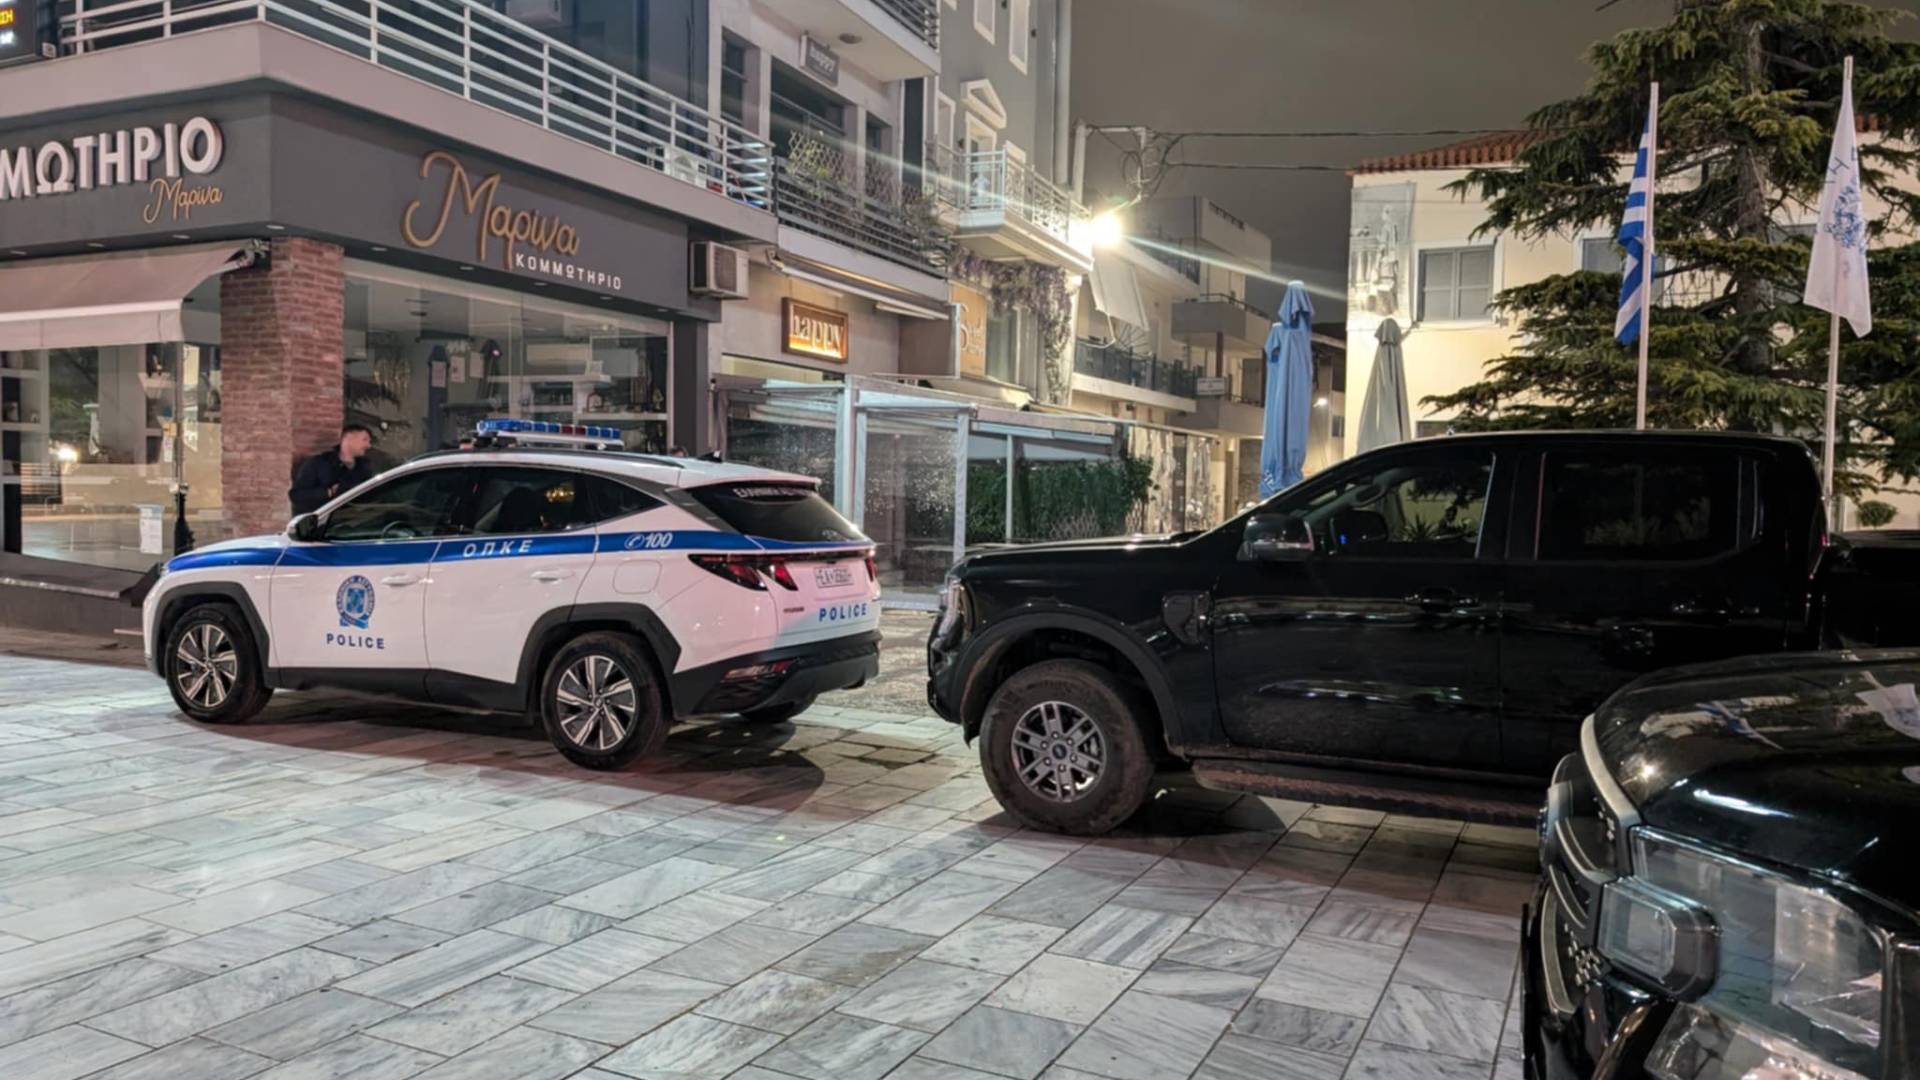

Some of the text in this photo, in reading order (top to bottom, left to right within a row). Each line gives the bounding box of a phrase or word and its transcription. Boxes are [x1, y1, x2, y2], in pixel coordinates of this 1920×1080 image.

[0, 116, 223, 199] ΜΩΤΗΡΙΟ
[515, 252, 622, 290] ΚΟΜΜΩΤΗΡΙΟ
[789, 302, 844, 353] happy
[644, 532, 673, 549] 100
[818, 603, 867, 622] POLICE
[326, 633, 385, 650] POLICE
